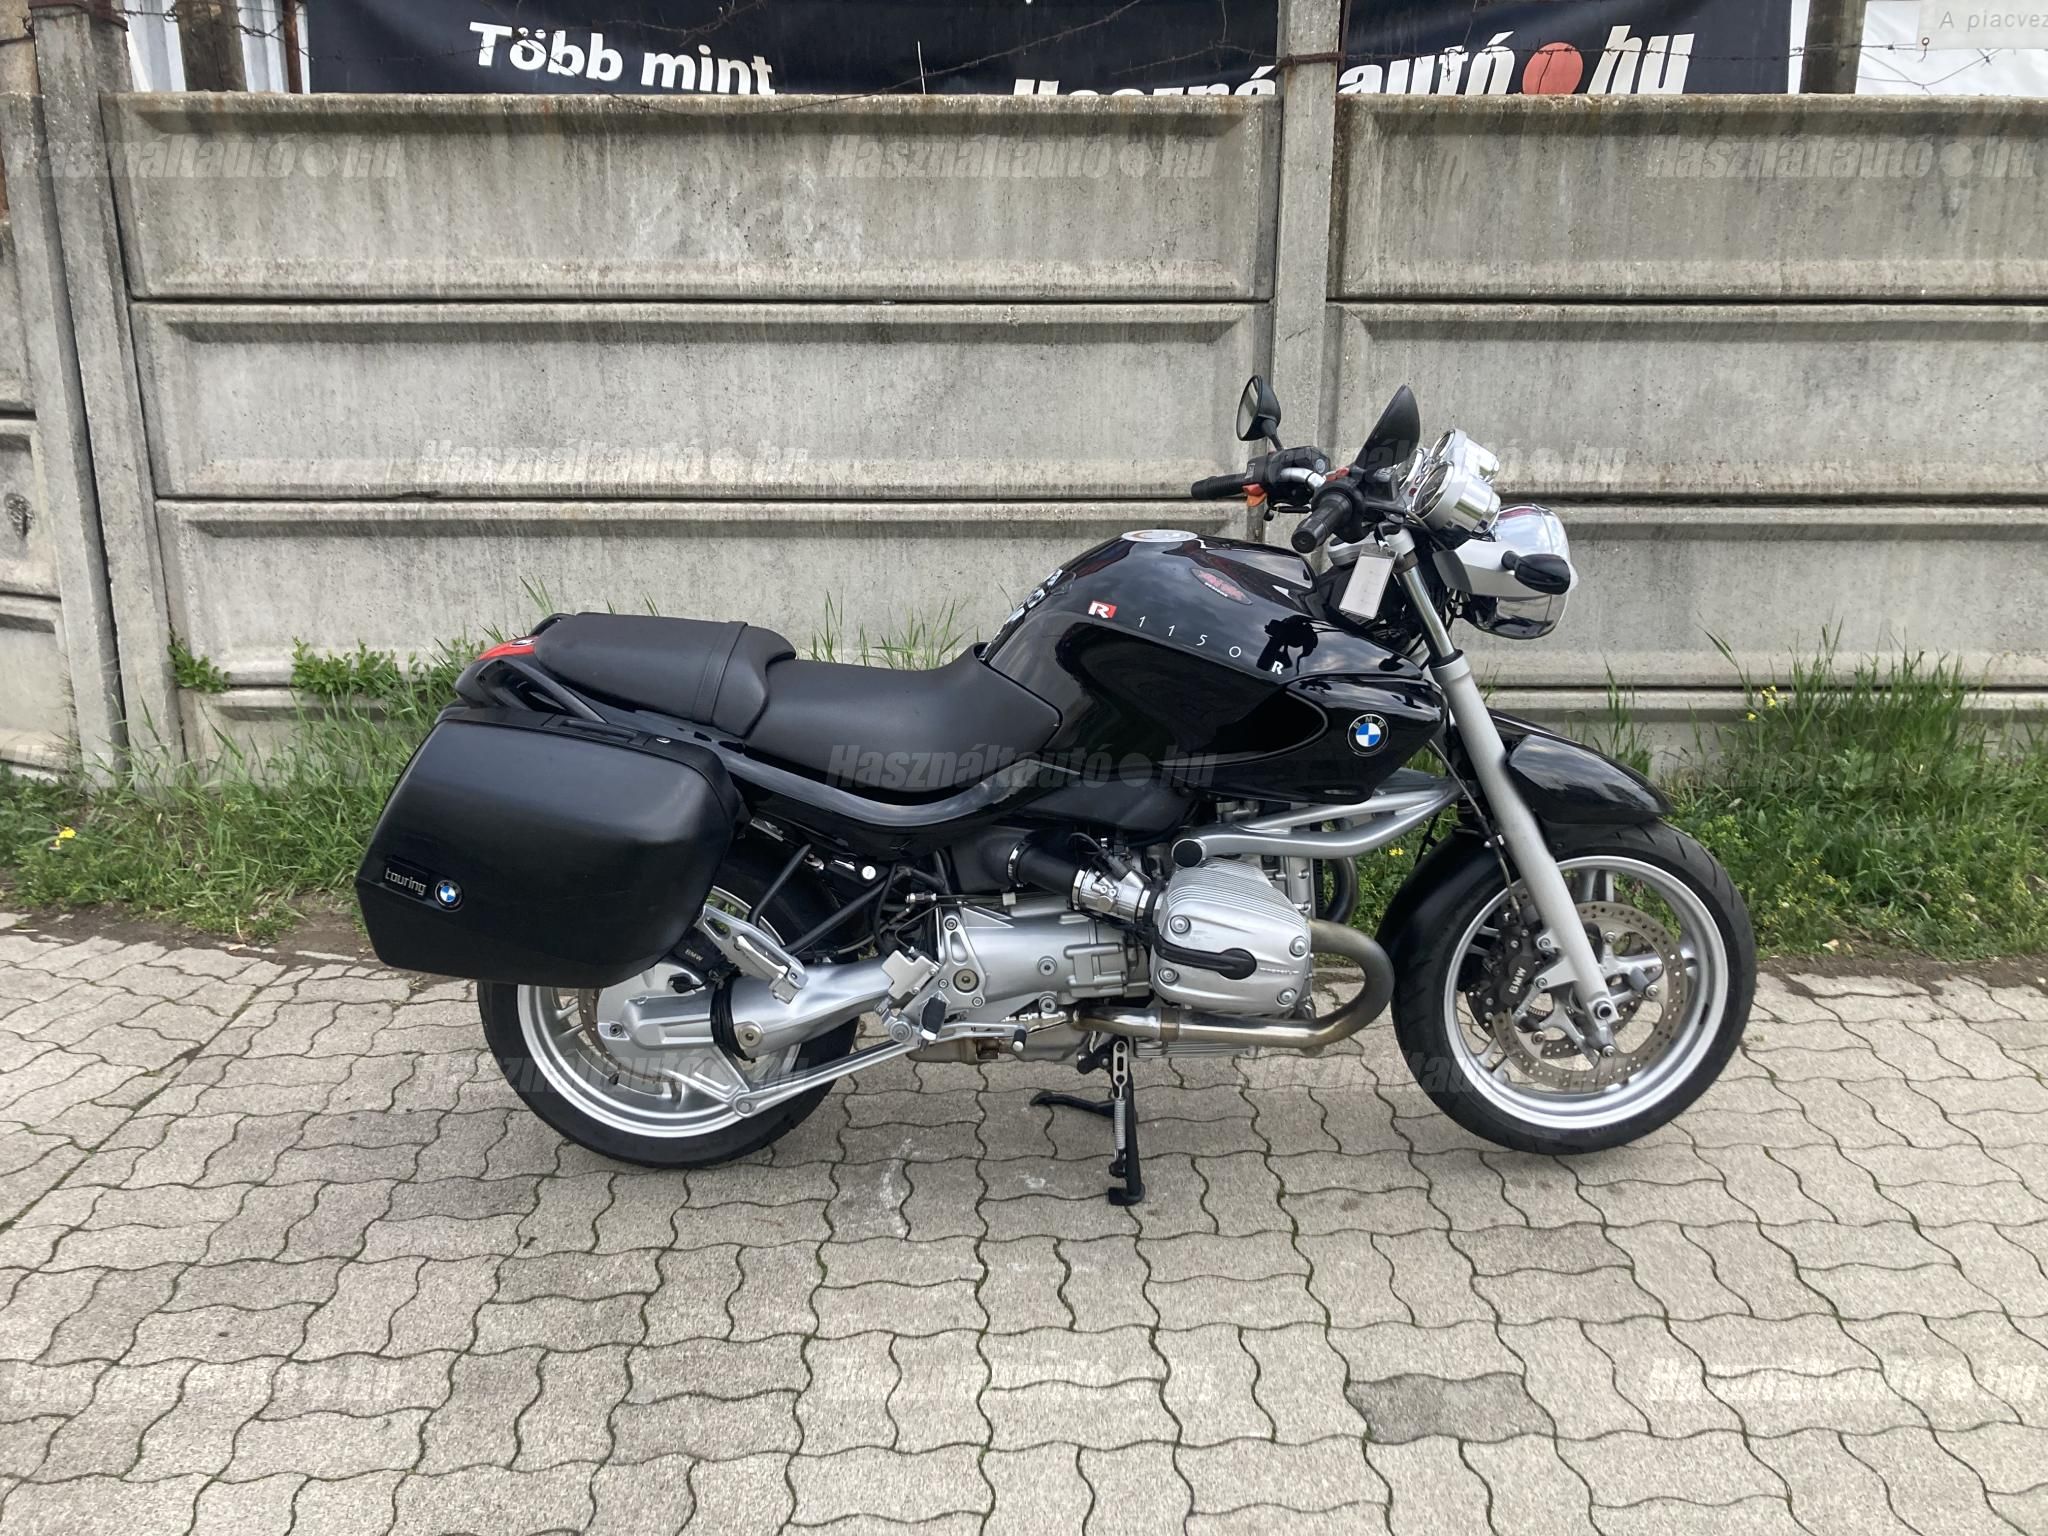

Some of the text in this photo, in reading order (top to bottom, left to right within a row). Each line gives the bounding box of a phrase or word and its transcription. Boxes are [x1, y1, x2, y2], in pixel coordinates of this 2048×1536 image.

[1939, 11, 1955, 29] A
[469, 21, 777, 95] Több mint
[1088, 600, 1111, 619] R
[1271, 660, 1284, 675] R
[385, 867, 427, 896] touring
[684, 948, 704, 962] BMW
[1508, 966, 1527, 995] BMW
